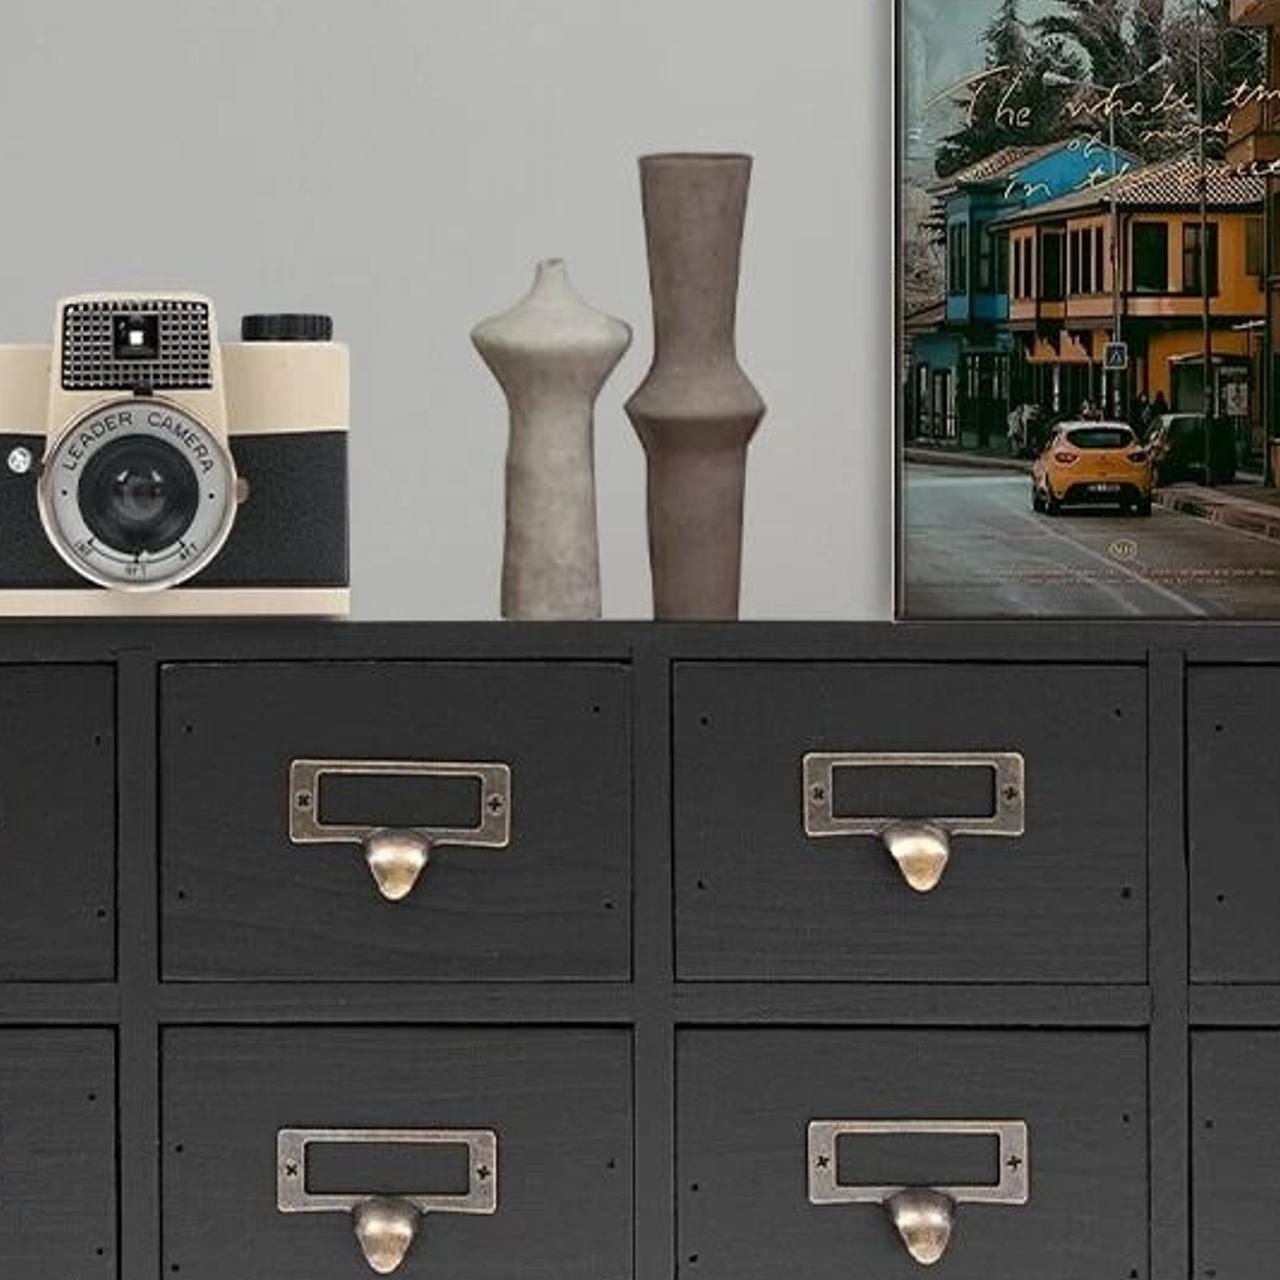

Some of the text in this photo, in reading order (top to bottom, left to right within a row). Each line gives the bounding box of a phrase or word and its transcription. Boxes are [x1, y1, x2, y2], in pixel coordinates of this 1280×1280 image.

[926, 65, 1032, 127] The
[62, 411, 214, 474] LEADER CAMERA
